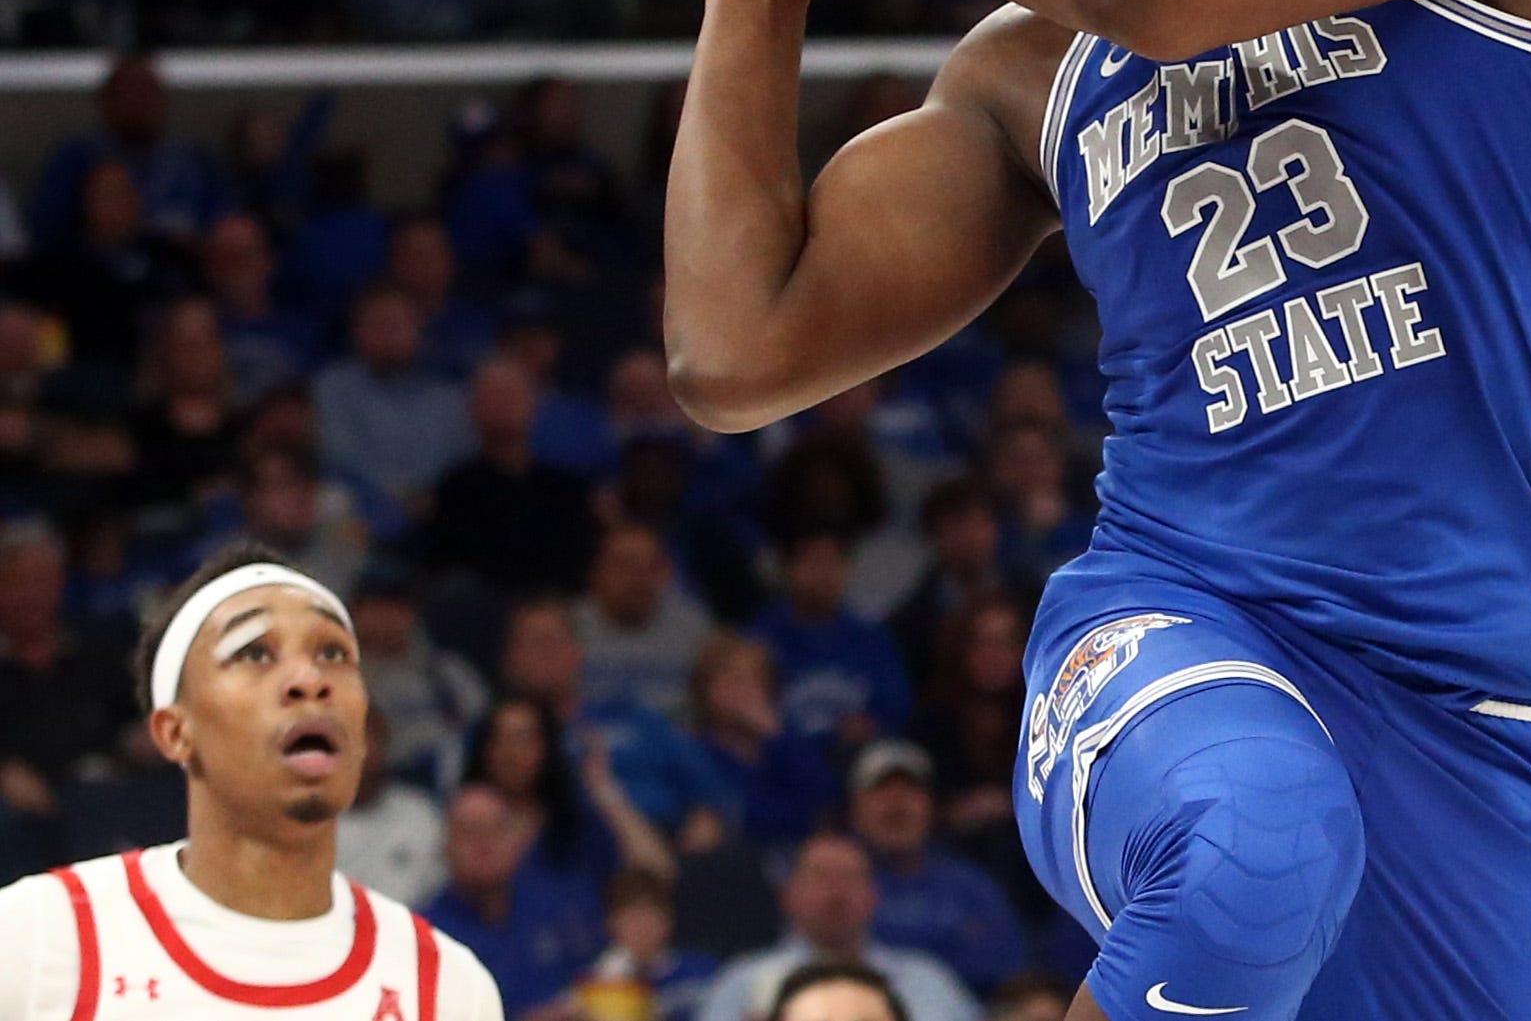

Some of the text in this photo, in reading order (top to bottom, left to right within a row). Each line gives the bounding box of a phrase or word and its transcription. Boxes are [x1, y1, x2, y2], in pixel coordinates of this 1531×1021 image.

[1078, 15, 1387, 226] MEMHIS
[1162, 118, 1369, 321] 23
[1192, 263, 1446, 434] STATE
